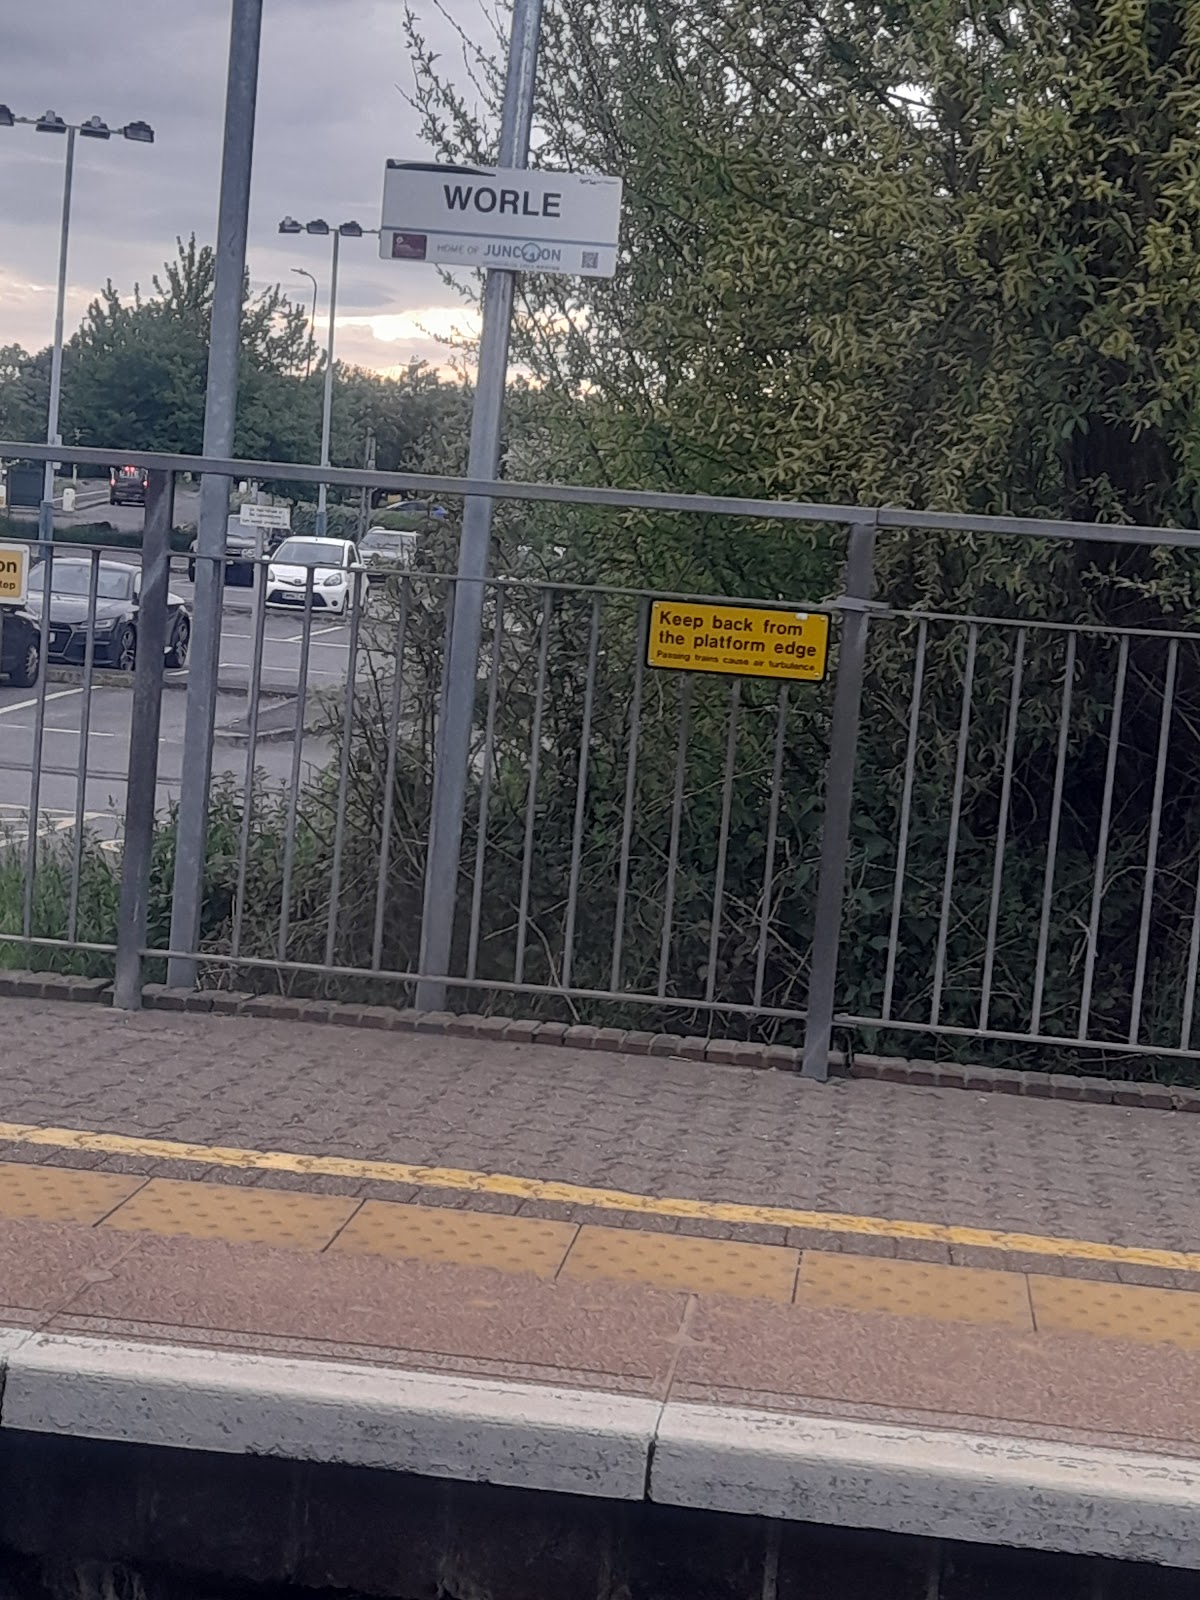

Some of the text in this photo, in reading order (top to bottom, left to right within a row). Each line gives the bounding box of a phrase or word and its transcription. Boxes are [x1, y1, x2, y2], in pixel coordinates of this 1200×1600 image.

[443, 184, 562, 218] WORLE
[437, 244, 464, 256] HOME
[483, 242, 562, 262] JUNCON
[659, 610, 803, 636] Keep back from
[659, 630, 817, 658] the platform edge
[656, 649, 691, 662] Passing
[695, 654, 719, 663] trains
[723, 657, 749, 666] cause
[769, 660, 815, 671] turbulence
